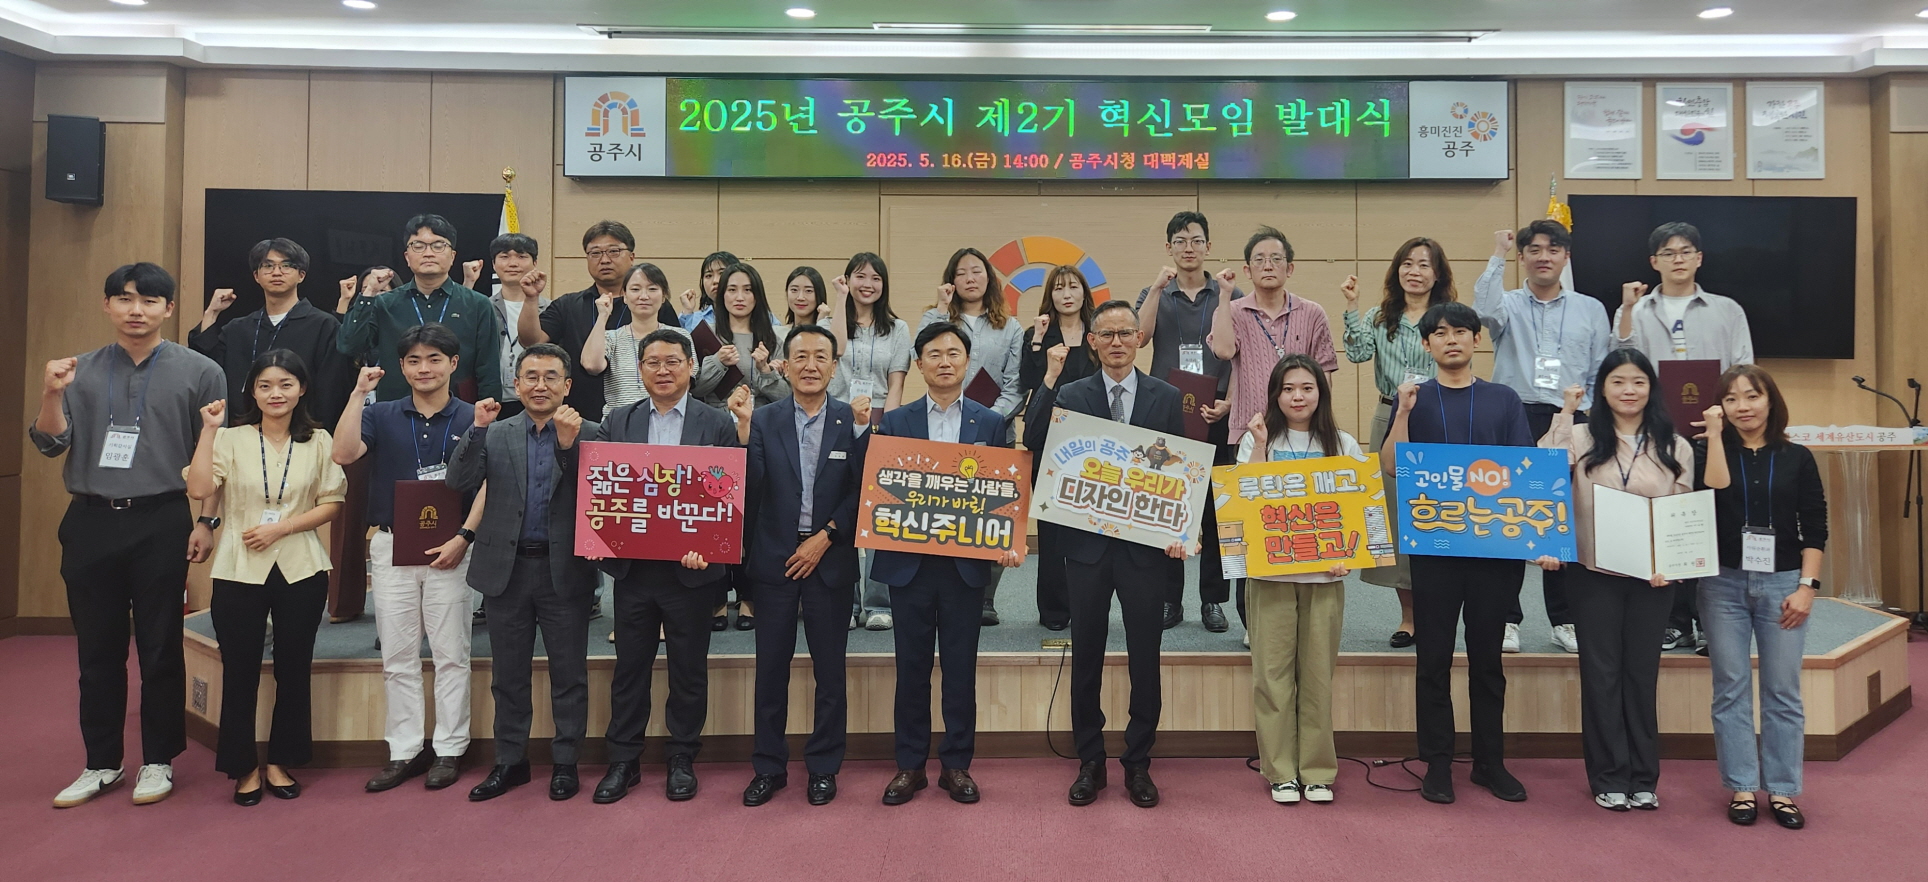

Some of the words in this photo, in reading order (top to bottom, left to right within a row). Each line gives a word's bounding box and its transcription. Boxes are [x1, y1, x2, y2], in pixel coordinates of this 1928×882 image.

[679, 96, 818, 134] 2025년
[837, 97, 954, 137] 공주시
[976, 97, 1076, 138] 제2기
[1098, 98, 1254, 138] 혁신모임
[1275, 98, 1392, 138] 발대식
[1417, 125, 1463, 138] 흥미진진
[587, 142, 642, 162] 공주시
[866, 152, 913, 168] 2025.
[919, 152, 935, 168] 5.
[942, 152, 997, 169] 16.(금)
[1003, 153, 1049, 168] 14:00
[1069, 152, 1136, 170] 공주시청
[1143, 152, 1210, 170] 대백제실
[1442, 141, 1476, 158] 공주
[1054, 438, 1096, 465] 내일의
[1100, 438, 1131, 462] 공주
[1785, 432, 1811, 441] 스코
[1815, 431, 1874, 442] 세계유산도시
[1876, 431, 1896, 442] 공주
[586, 460, 634, 495] 젊은
[636, 463, 693, 497] 심장!
[878, 469, 923, 489] 생각을
[925, 473, 969, 493] 깨우는
[971, 478, 1019, 499] 사람들,
[1080, 457, 1123, 486] 오늘
[1124, 466, 1187, 501] 우리가
[1238, 473, 1307, 500] 루틴은
[1311, 468, 1367, 494] 깨고,
[1414, 465, 1465, 491] 고인물
[1469, 468, 1510, 487] NO!
[585, 497, 652, 534] 공주를
[657, 499, 733, 533] 바꾼다!
[905, 491, 949, 508] 우리가
[952, 497, 986, 515] 바로!
[1059, 476, 1131, 516] 디자인
[1133, 493, 1184, 528] 한다
[1260, 500, 1342, 532] 혁신은
[875, 507, 1012, 548] 혁신주니어
[1264, 530, 1360, 565] 만들고!
